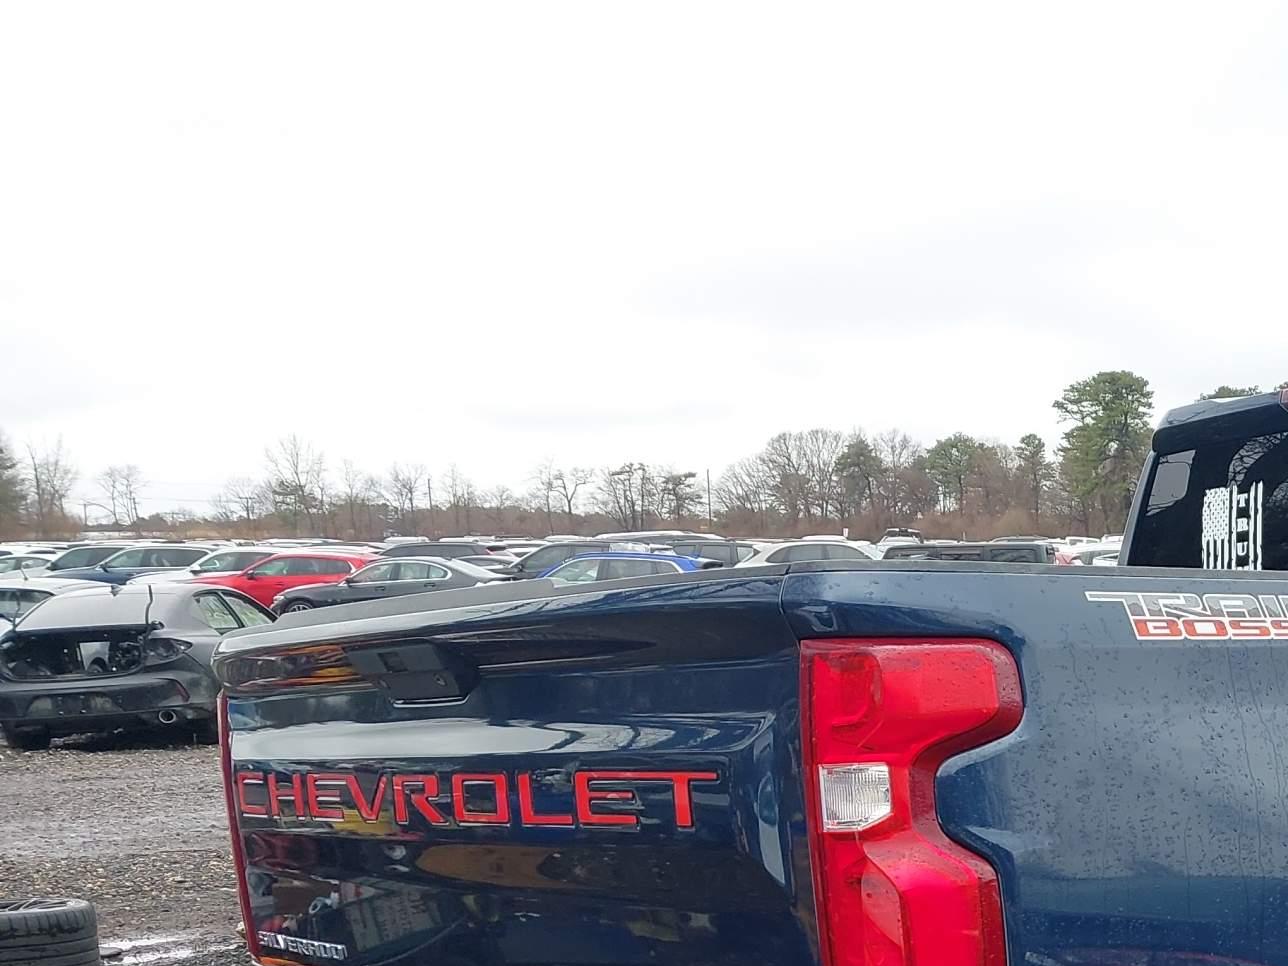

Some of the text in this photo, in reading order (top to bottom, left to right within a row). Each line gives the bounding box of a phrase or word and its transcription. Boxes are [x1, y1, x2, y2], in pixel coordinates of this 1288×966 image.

[1236, 493, 1250, 570] TRU
[237, 771, 718, 831] CHEVROLET
[257, 930, 348, 960] SILVERADO
